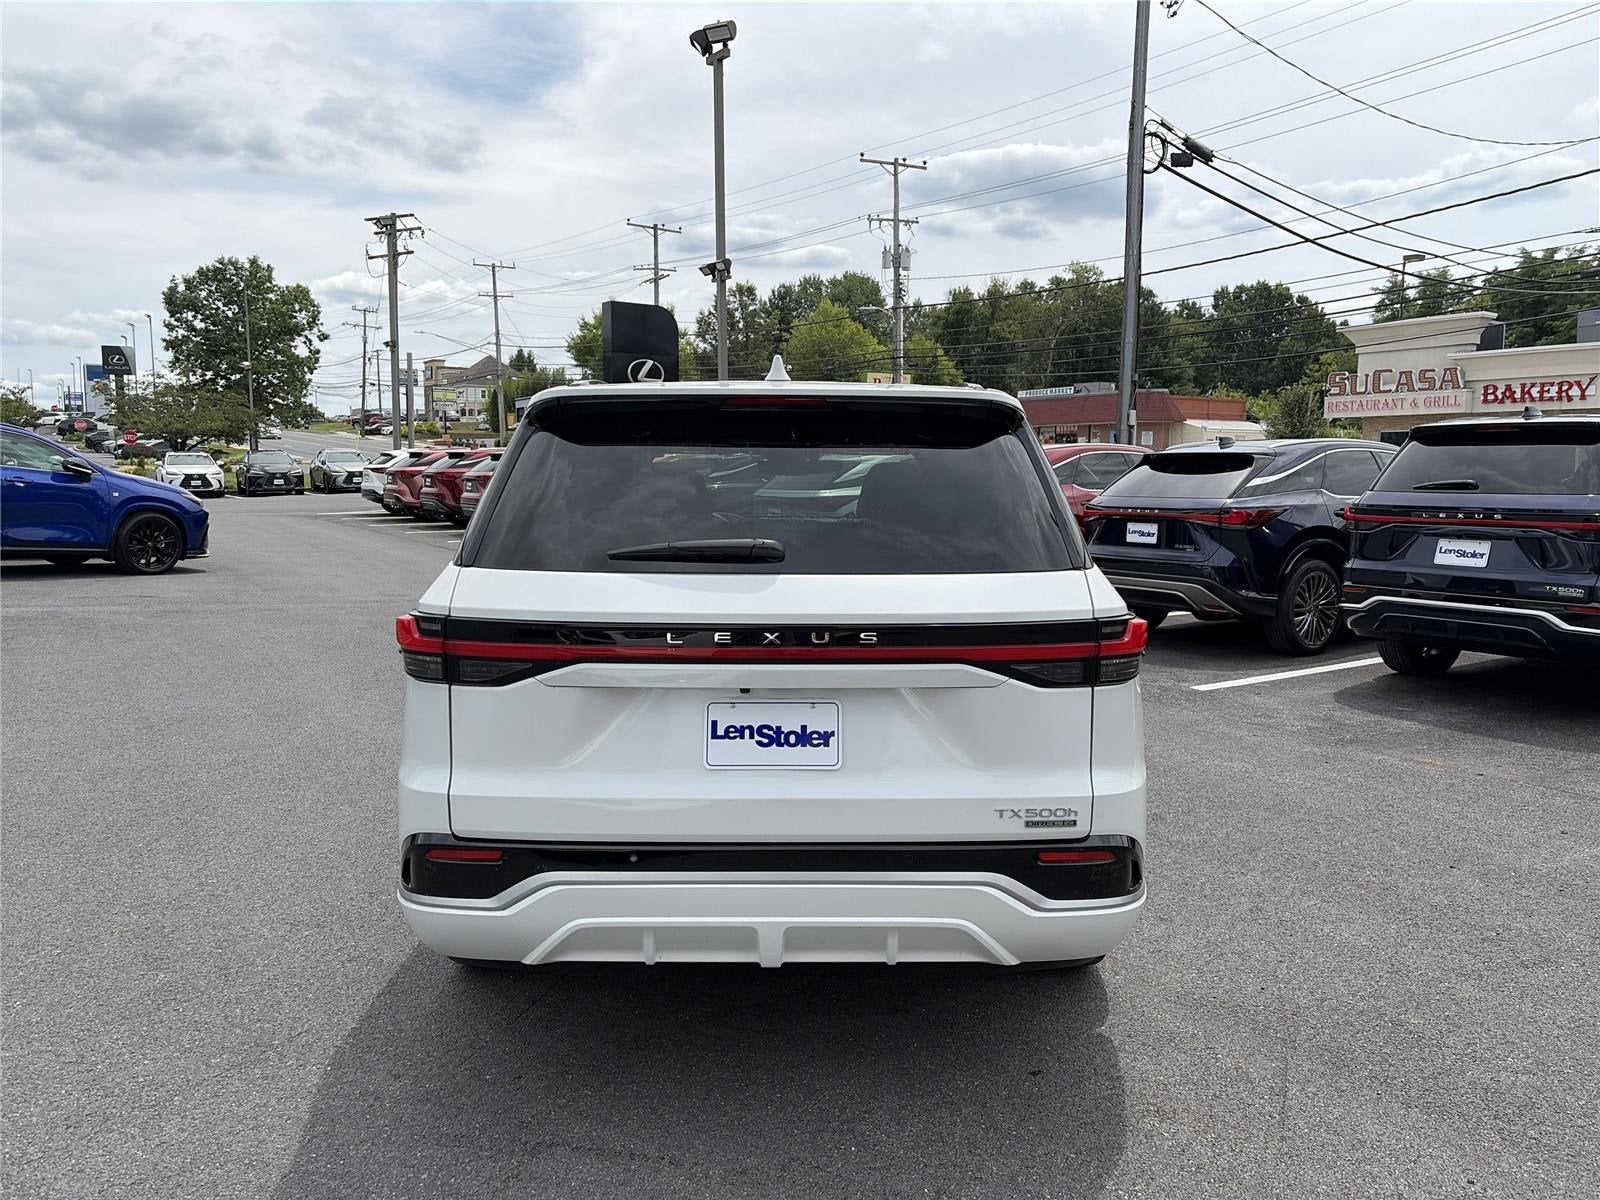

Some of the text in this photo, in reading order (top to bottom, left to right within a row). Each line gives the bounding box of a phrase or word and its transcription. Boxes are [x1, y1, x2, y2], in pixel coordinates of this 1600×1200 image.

[1024, 387, 1073, 397] PRODUCE MARKET
[1481, 375, 1598, 405] BAKERY
[1327, 395, 1461, 412] RESTAURANT & GRILL
[666, 632, 878, 644] LEXUS
